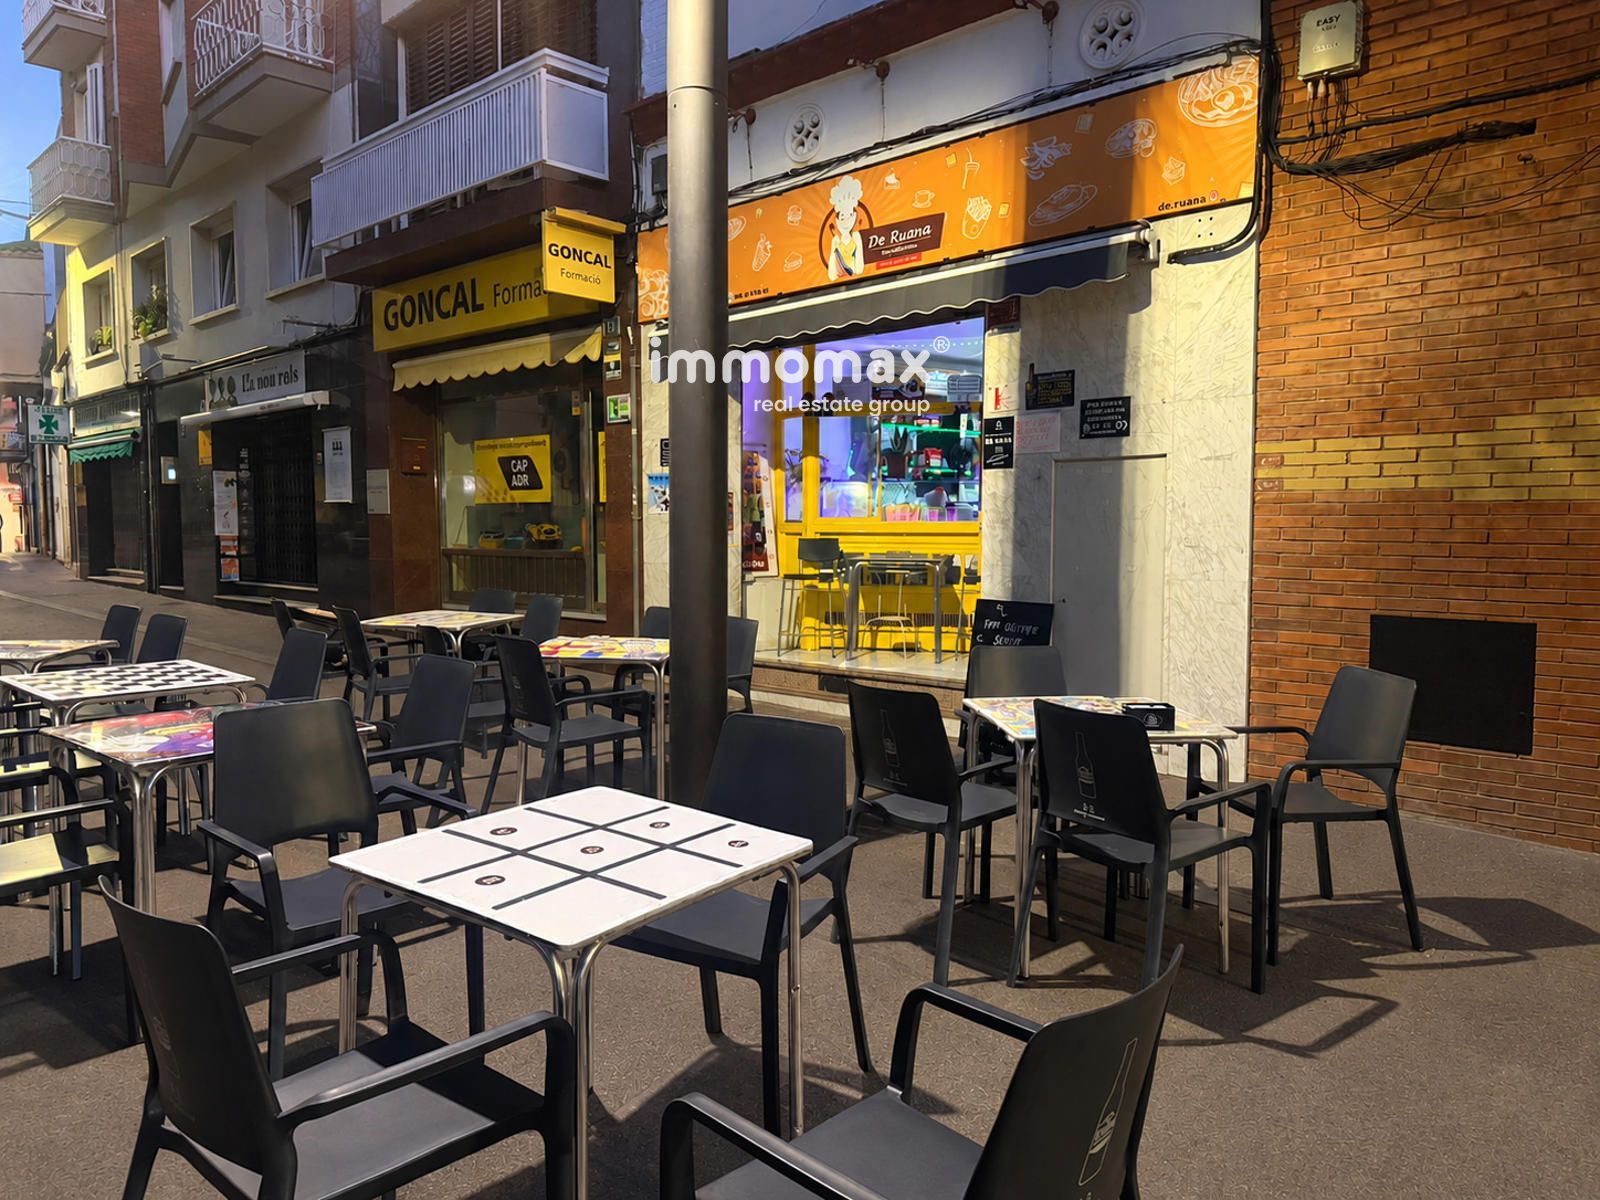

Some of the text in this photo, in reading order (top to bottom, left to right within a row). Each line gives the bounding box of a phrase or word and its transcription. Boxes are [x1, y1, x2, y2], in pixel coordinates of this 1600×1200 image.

[1158, 195, 1207, 211] de.ruana
[868, 224, 932, 249] De Ruana
[548, 243, 612, 269] GONCAL
[560, 267, 601, 285] Formació
[383, 277, 484, 332] GONCAL
[511, 459, 528, 473] CAP
[511, 474, 529, 487] ADR
